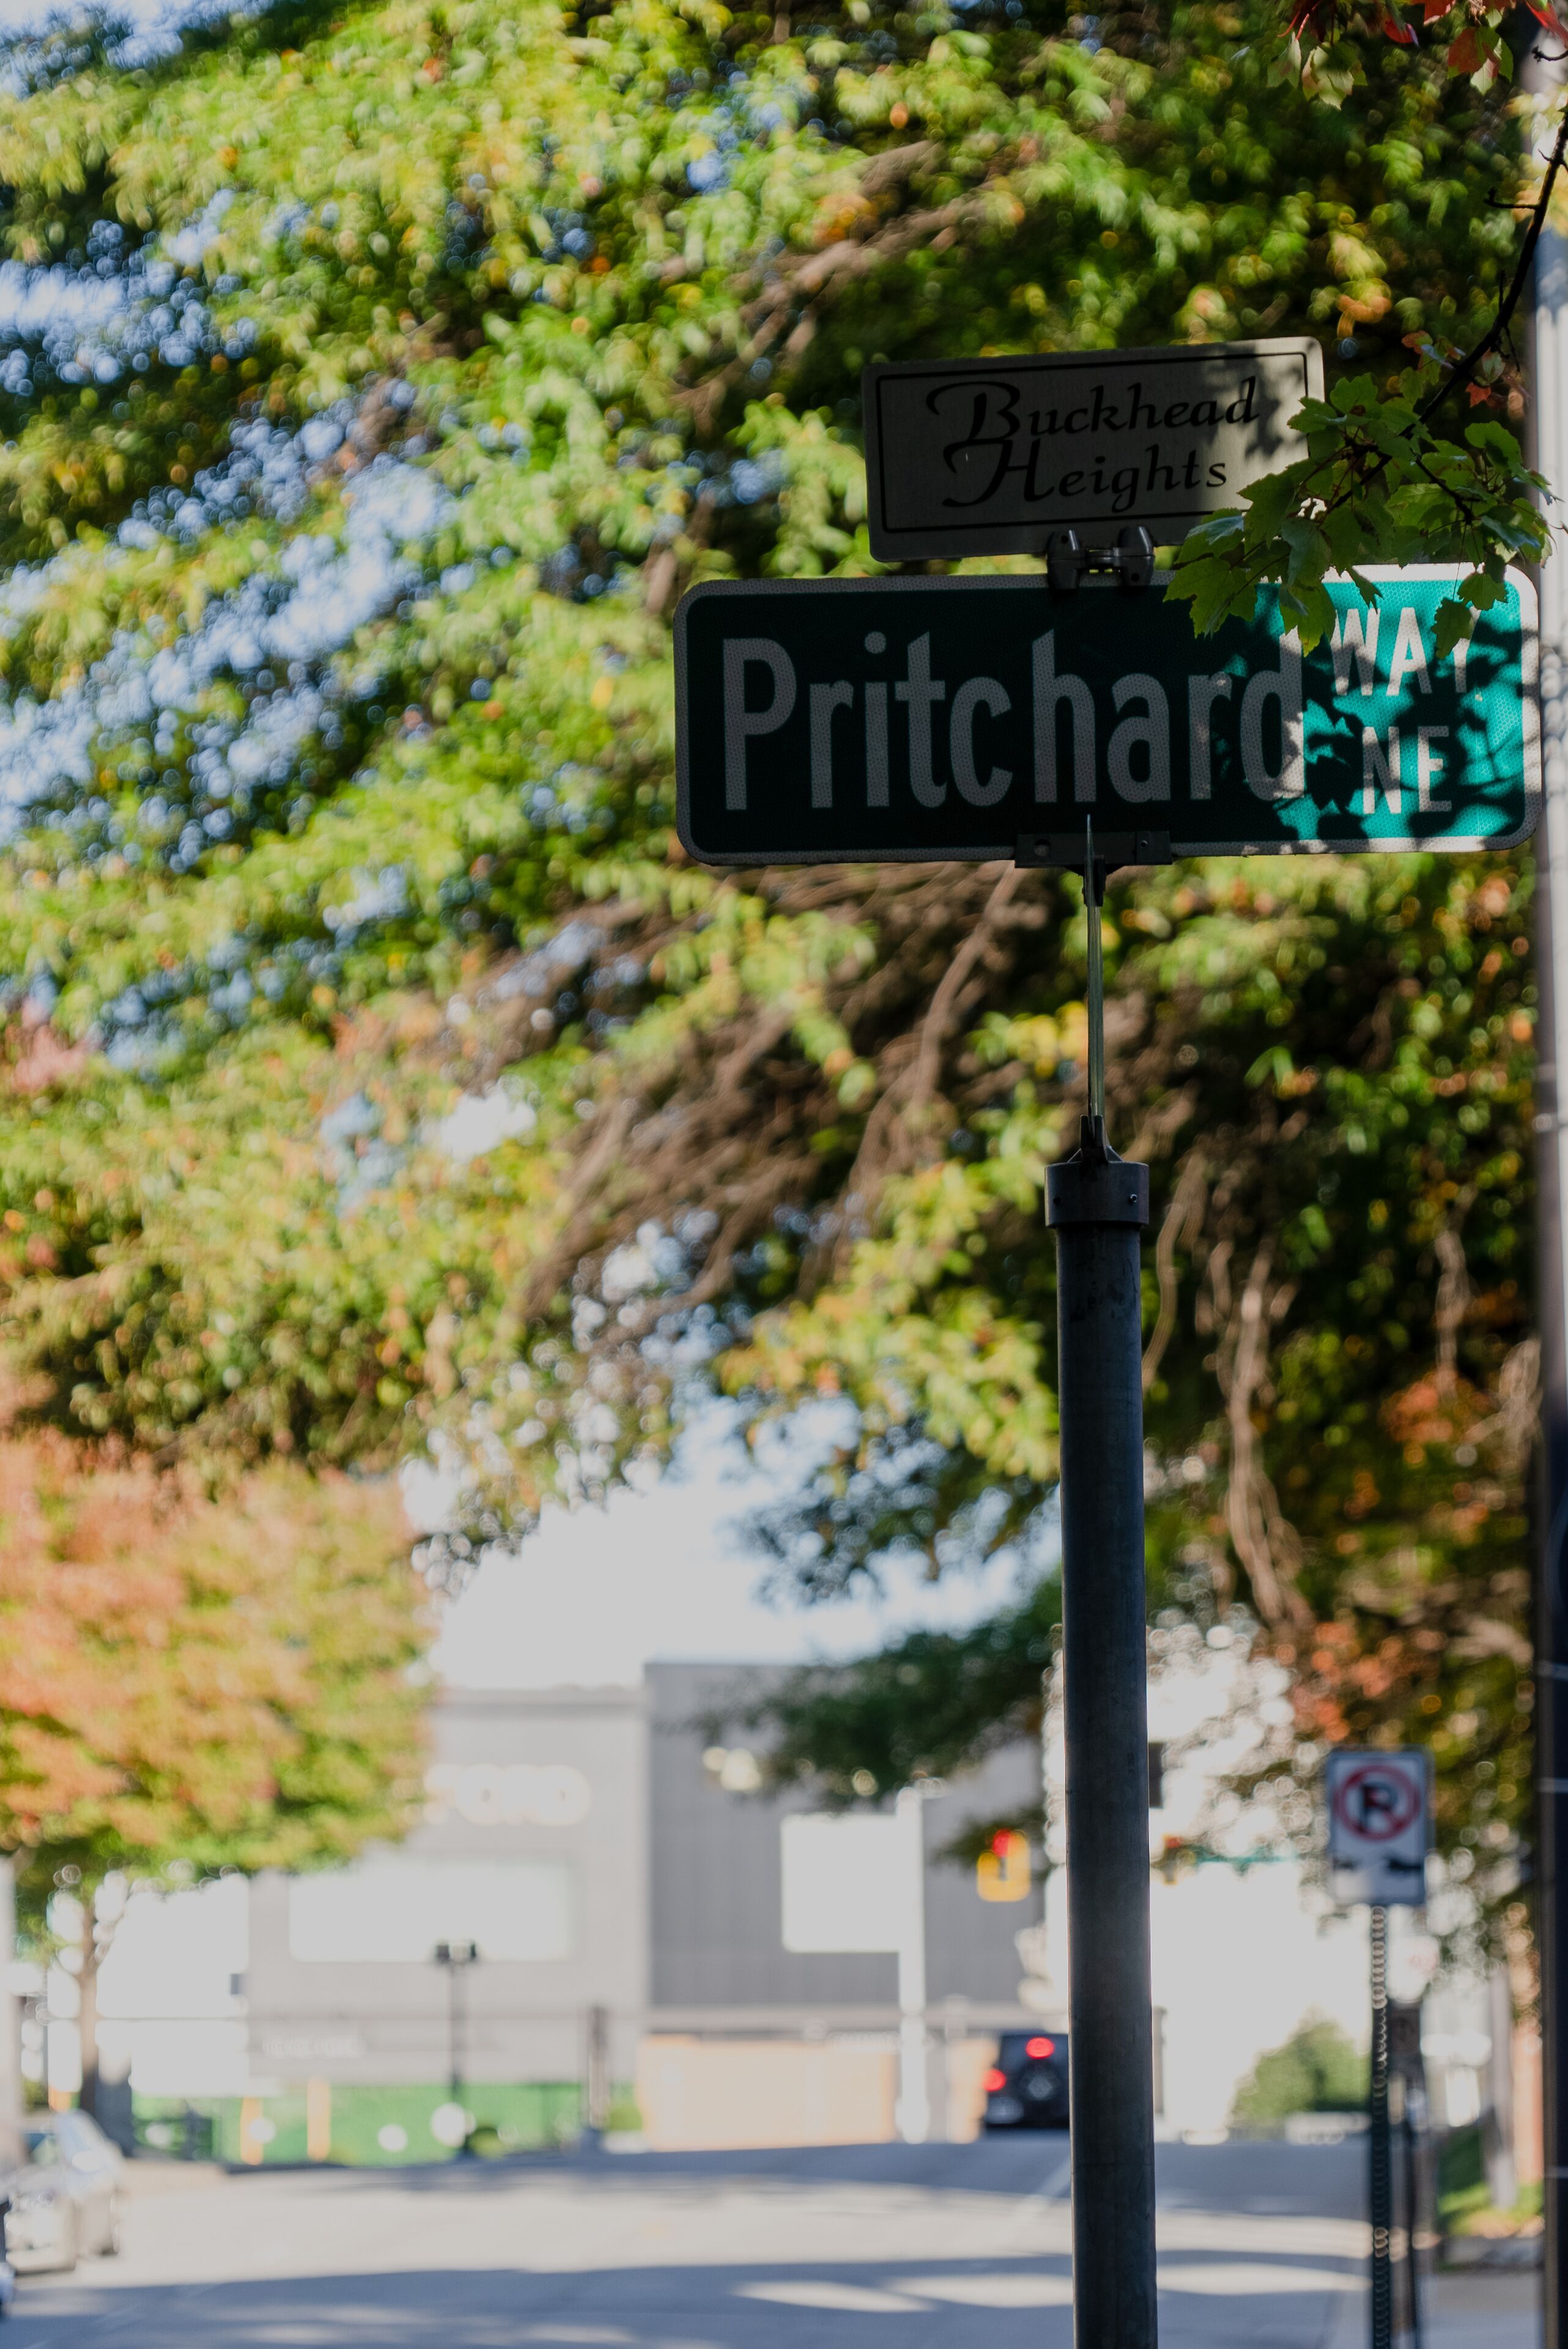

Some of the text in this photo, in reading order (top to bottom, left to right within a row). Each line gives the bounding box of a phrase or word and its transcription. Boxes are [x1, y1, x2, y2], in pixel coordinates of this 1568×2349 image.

[926, 376, 1260, 443] Buckhead
[942, 438, 1227, 513] Heights
[722, 627, 1305, 811] Pritchard
[1361, 725, 1452, 814] NE
